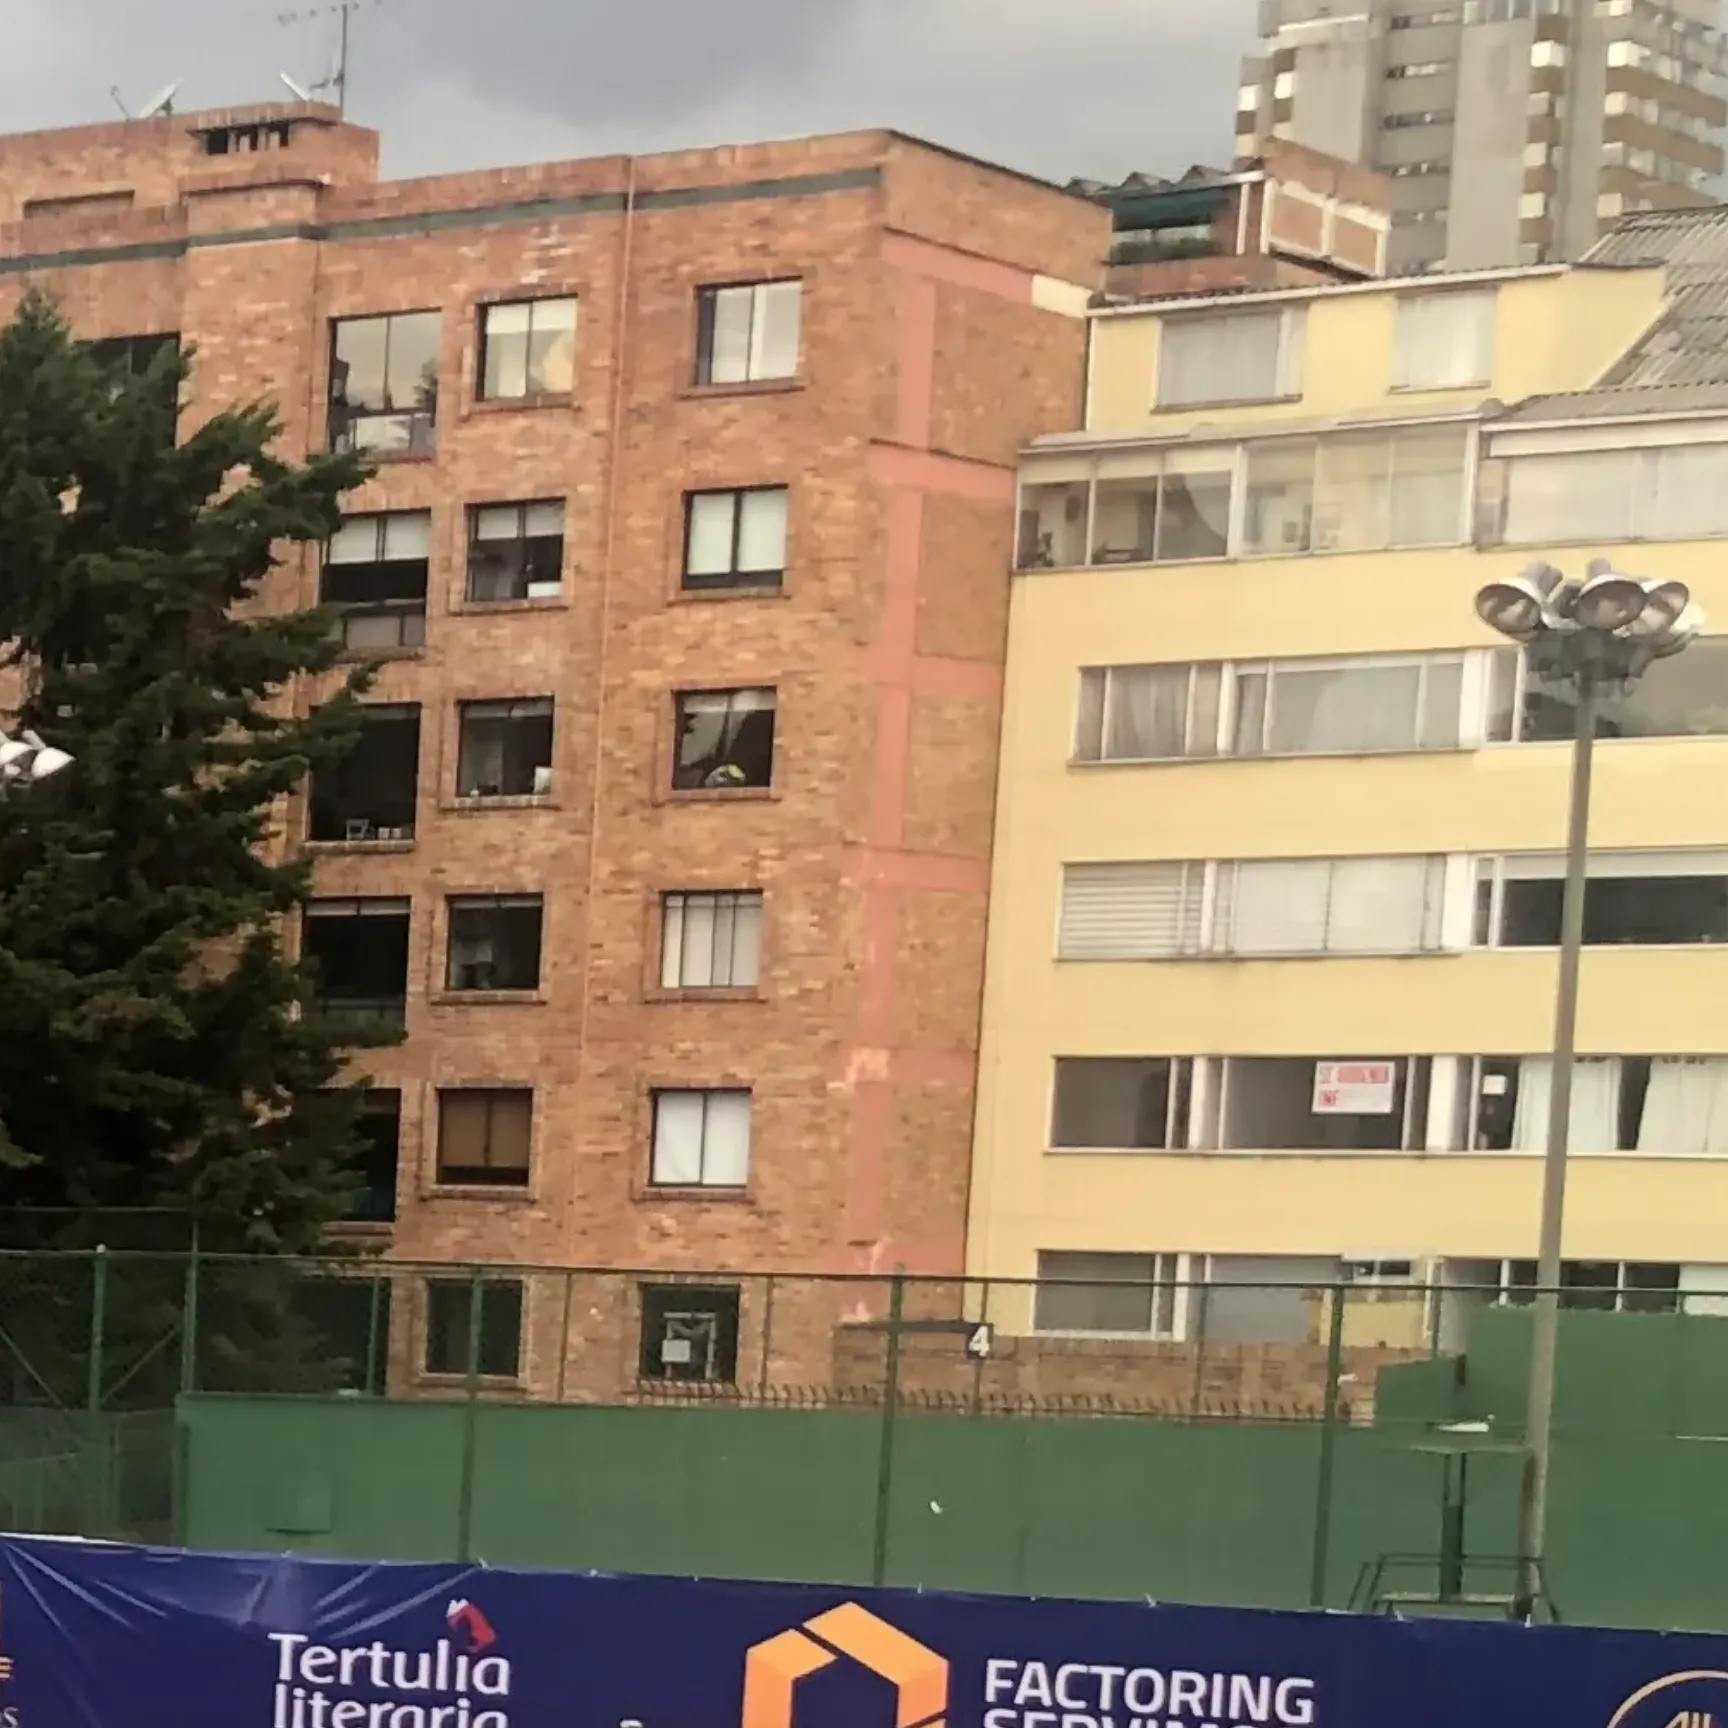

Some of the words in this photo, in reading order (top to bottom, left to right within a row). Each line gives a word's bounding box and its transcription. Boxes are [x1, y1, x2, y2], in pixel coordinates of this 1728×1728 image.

[969, 1325, 989, 1357] 4
[267, 1632, 510, 1696] Tertulia
[984, 1658, 1315, 1724] FACTORING
